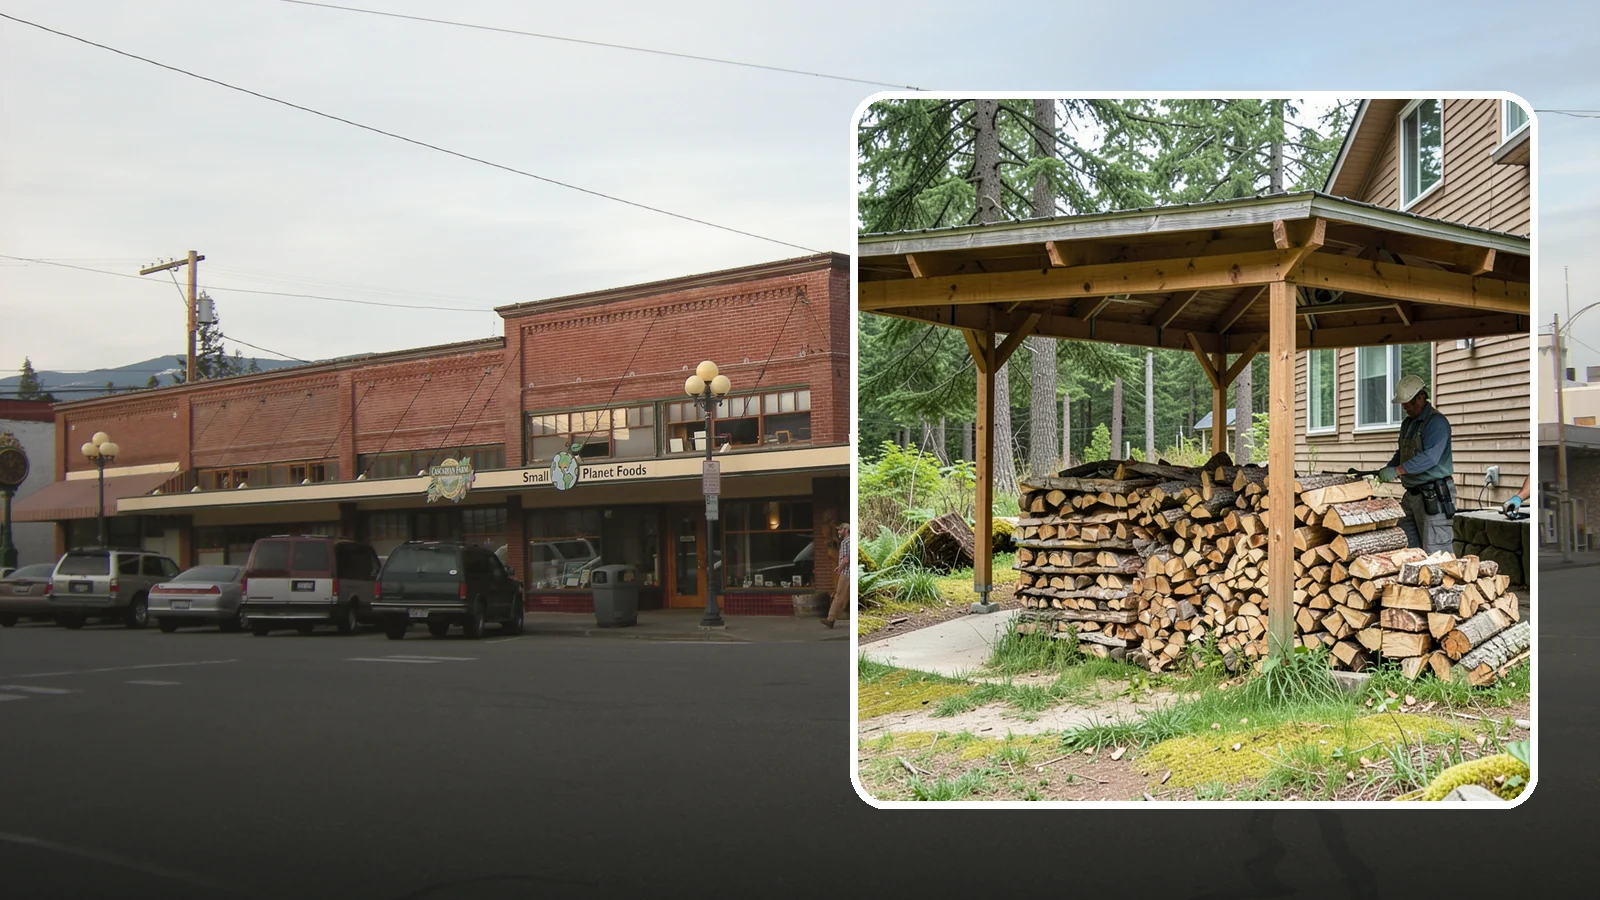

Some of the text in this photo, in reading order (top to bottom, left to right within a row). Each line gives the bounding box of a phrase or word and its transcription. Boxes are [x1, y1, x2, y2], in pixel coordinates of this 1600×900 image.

[523, 464, 647, 483] Small Planet Foods
